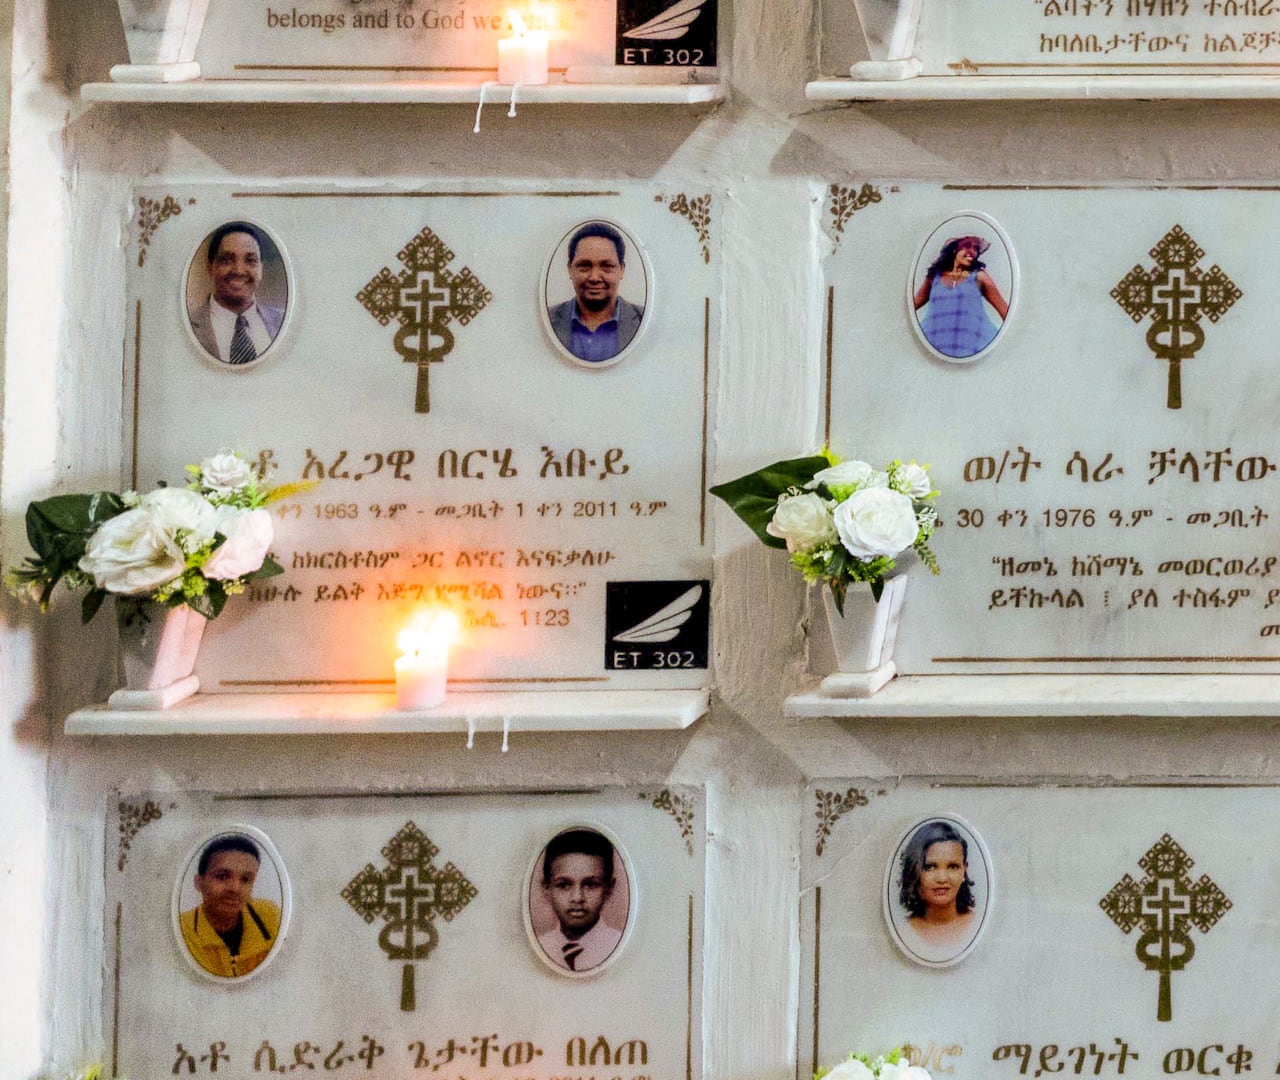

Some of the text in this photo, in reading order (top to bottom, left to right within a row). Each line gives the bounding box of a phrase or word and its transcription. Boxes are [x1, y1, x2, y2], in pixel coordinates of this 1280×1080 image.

[623, 48, 704, 65] ET 302
[1039, 31, 1188, 54] ከባለቤታቸውና
[301, 445, 630, 481] አረጋዊ በርሄ እቡይ
[963, 445, 1042, 484] ወ/ት
[1065, 450, 1124, 483] ሳራ
[1148, 447, 1277, 485] ቻላቸው
[613, 651, 694, 668] ET 302
[171, 1033, 648, 1076] አቶ ሲድራቅ ጌታቸው በለጠ
[992, 1037, 1139, 1078] ማይገነት
[1162, 1044, 1253, 1077] ወርቁ
